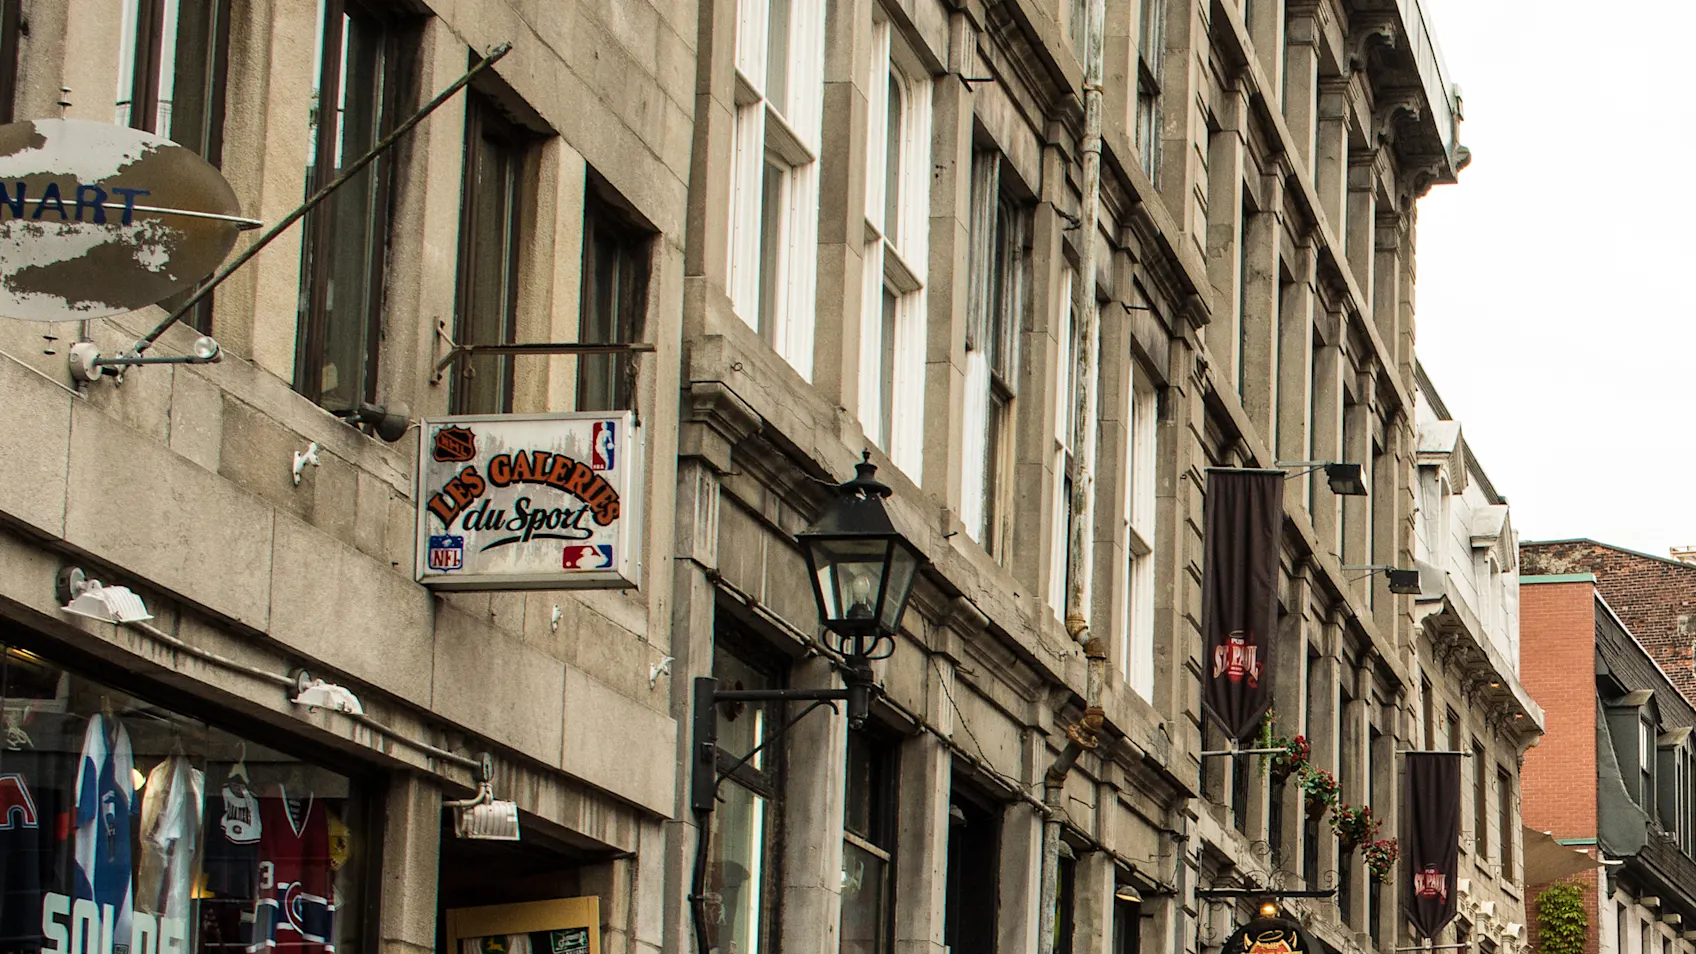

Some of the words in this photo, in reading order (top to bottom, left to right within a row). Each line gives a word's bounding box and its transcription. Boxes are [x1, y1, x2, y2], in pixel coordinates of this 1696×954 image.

[427, 466, 486, 530] LES
[488, 449, 620, 526] GALERIES
[462, 498, 506, 531] du
[506, 497, 593, 542] Sport
[433, 551, 461, 567] NFL
